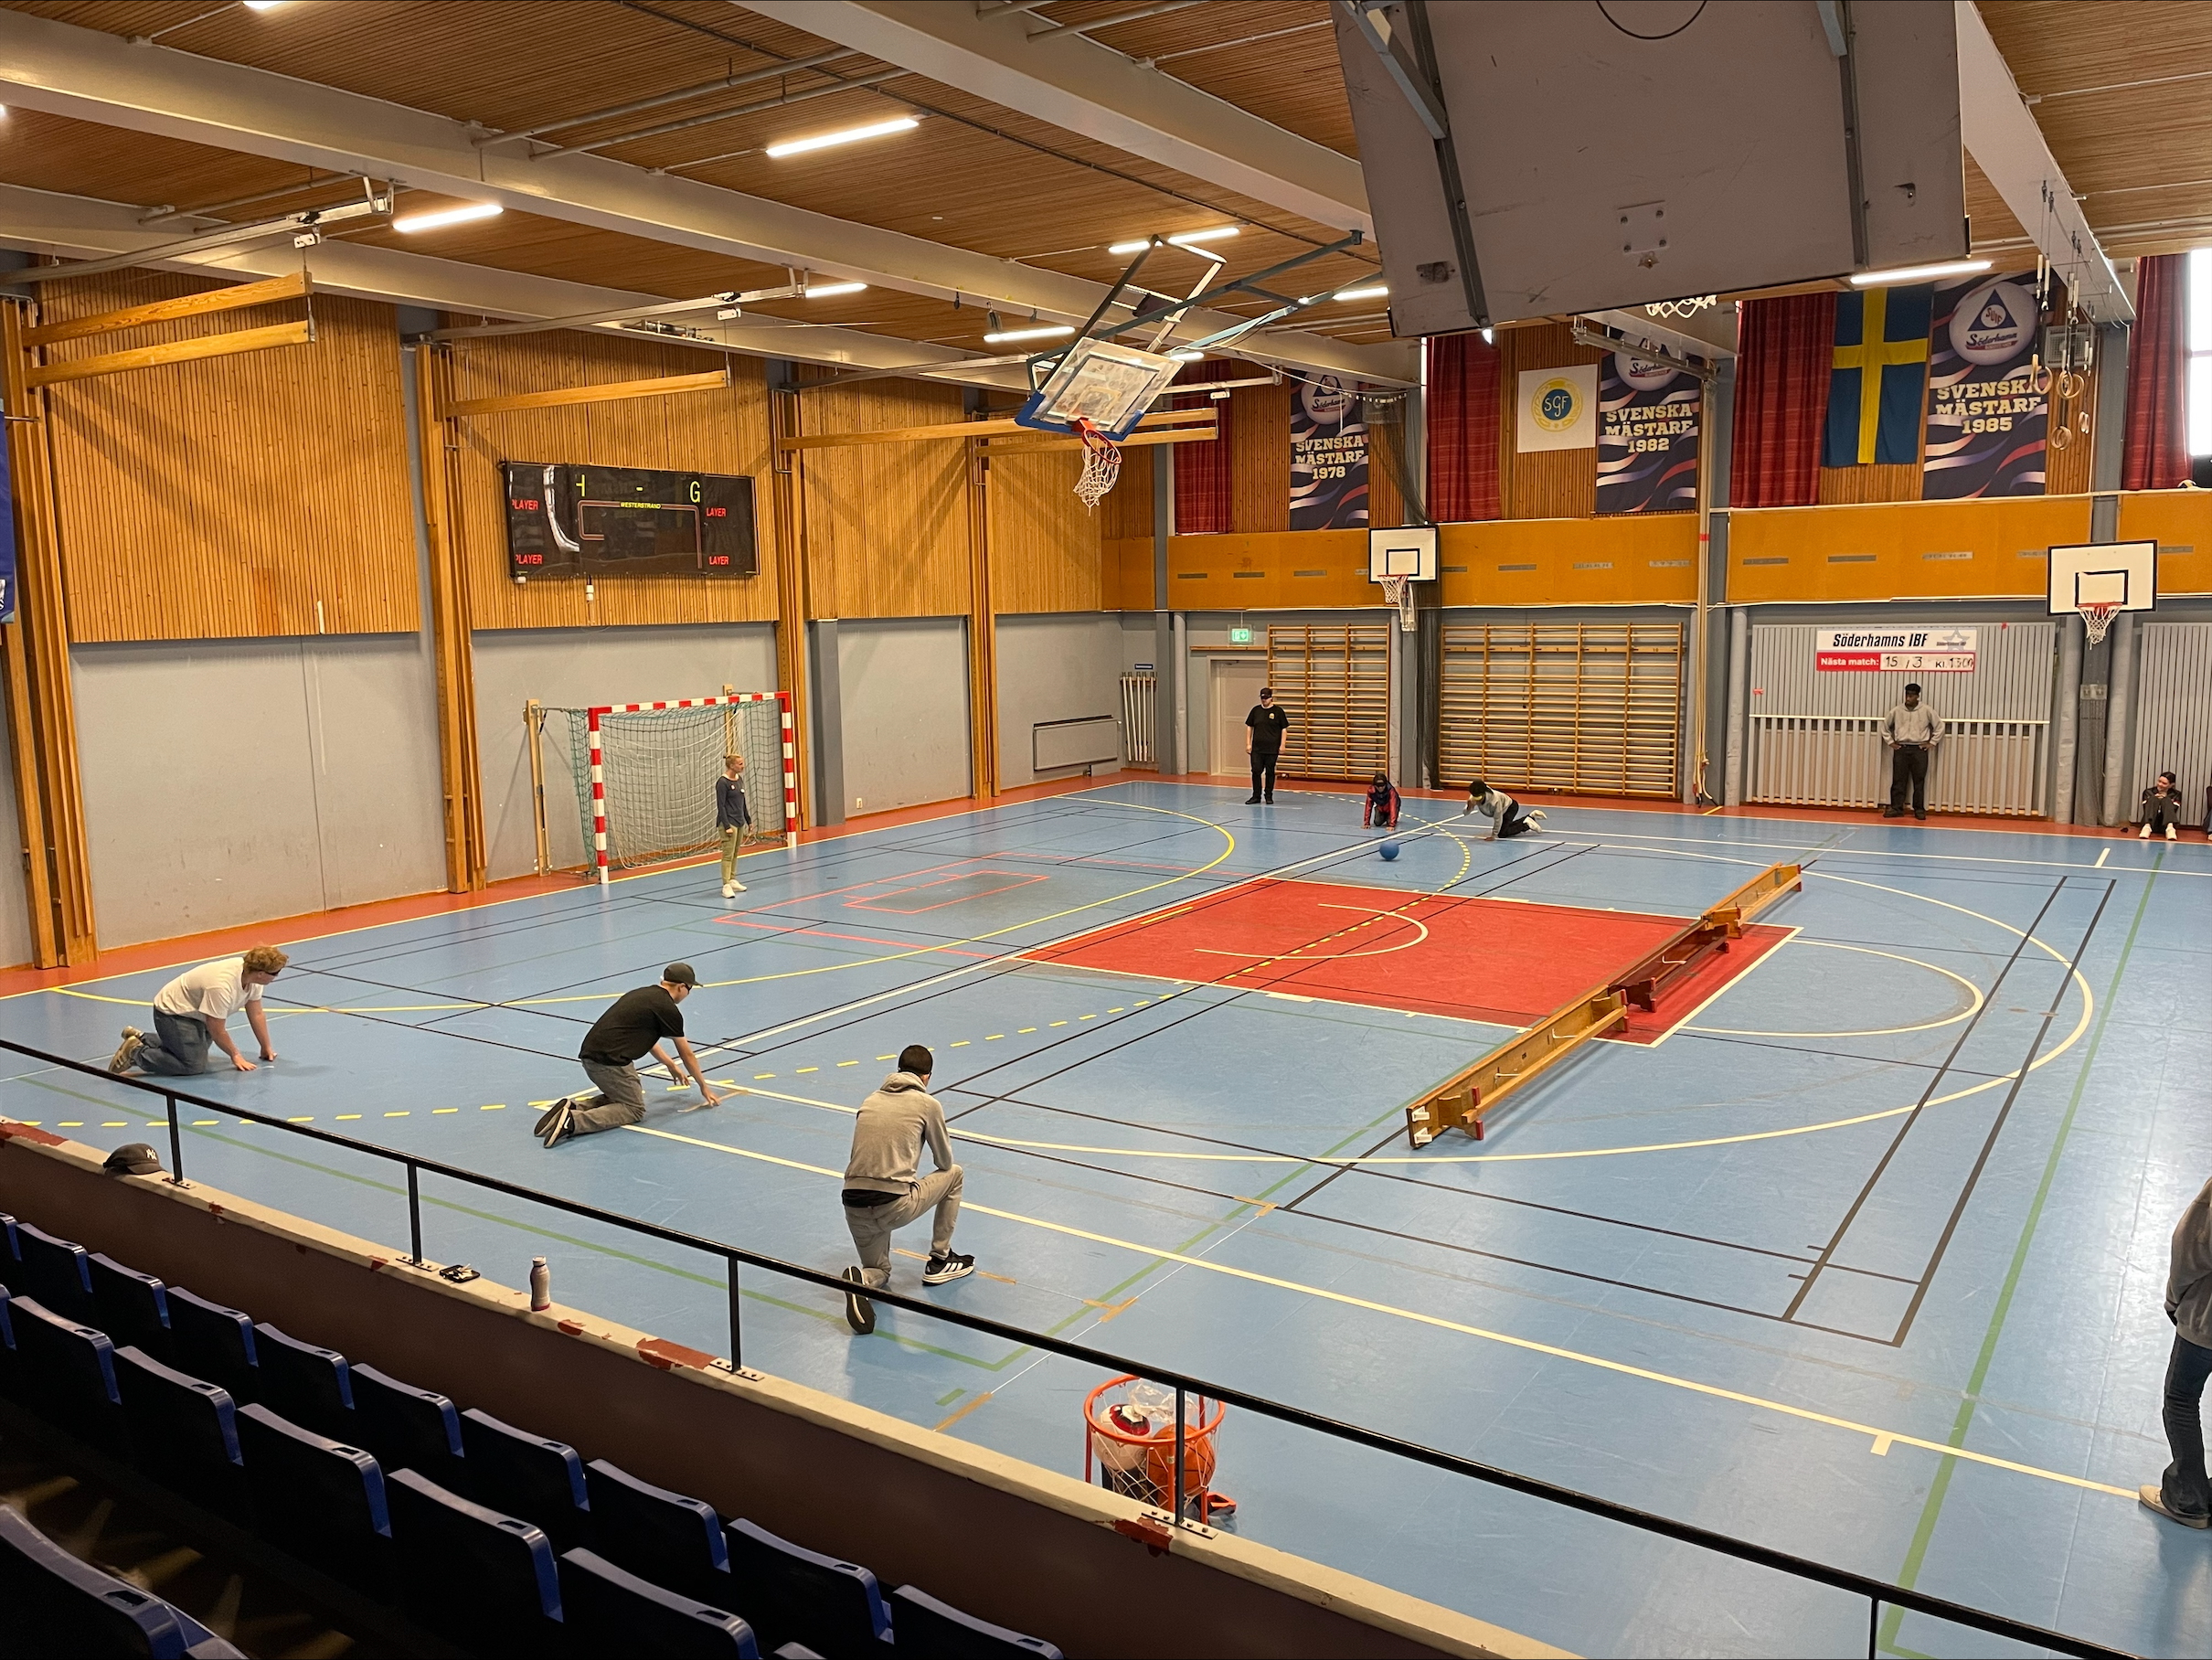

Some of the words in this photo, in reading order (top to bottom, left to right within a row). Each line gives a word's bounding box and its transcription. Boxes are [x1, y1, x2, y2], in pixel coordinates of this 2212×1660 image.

[1544, 395, 1569, 417] SGF
[1606, 403, 1693, 422] SVENSKA
[1962, 417, 2013, 434] 1985
[1295, 435, 1364, 452] SVENSKA
[1628, 438, 1669, 452] 1982
[1313, 466, 1345, 480] 1978
[690, 481, 701, 503] G
[1834, 633, 1905, 647] Söderhamns
[1909, 633, 1928, 647] IBF
[1821, 657, 1846, 665] Nästa
[1848, 657, 1879, 665] match:
[1886, 656, 1898, 667] 15
[1912, 656, 1922, 668] 3
